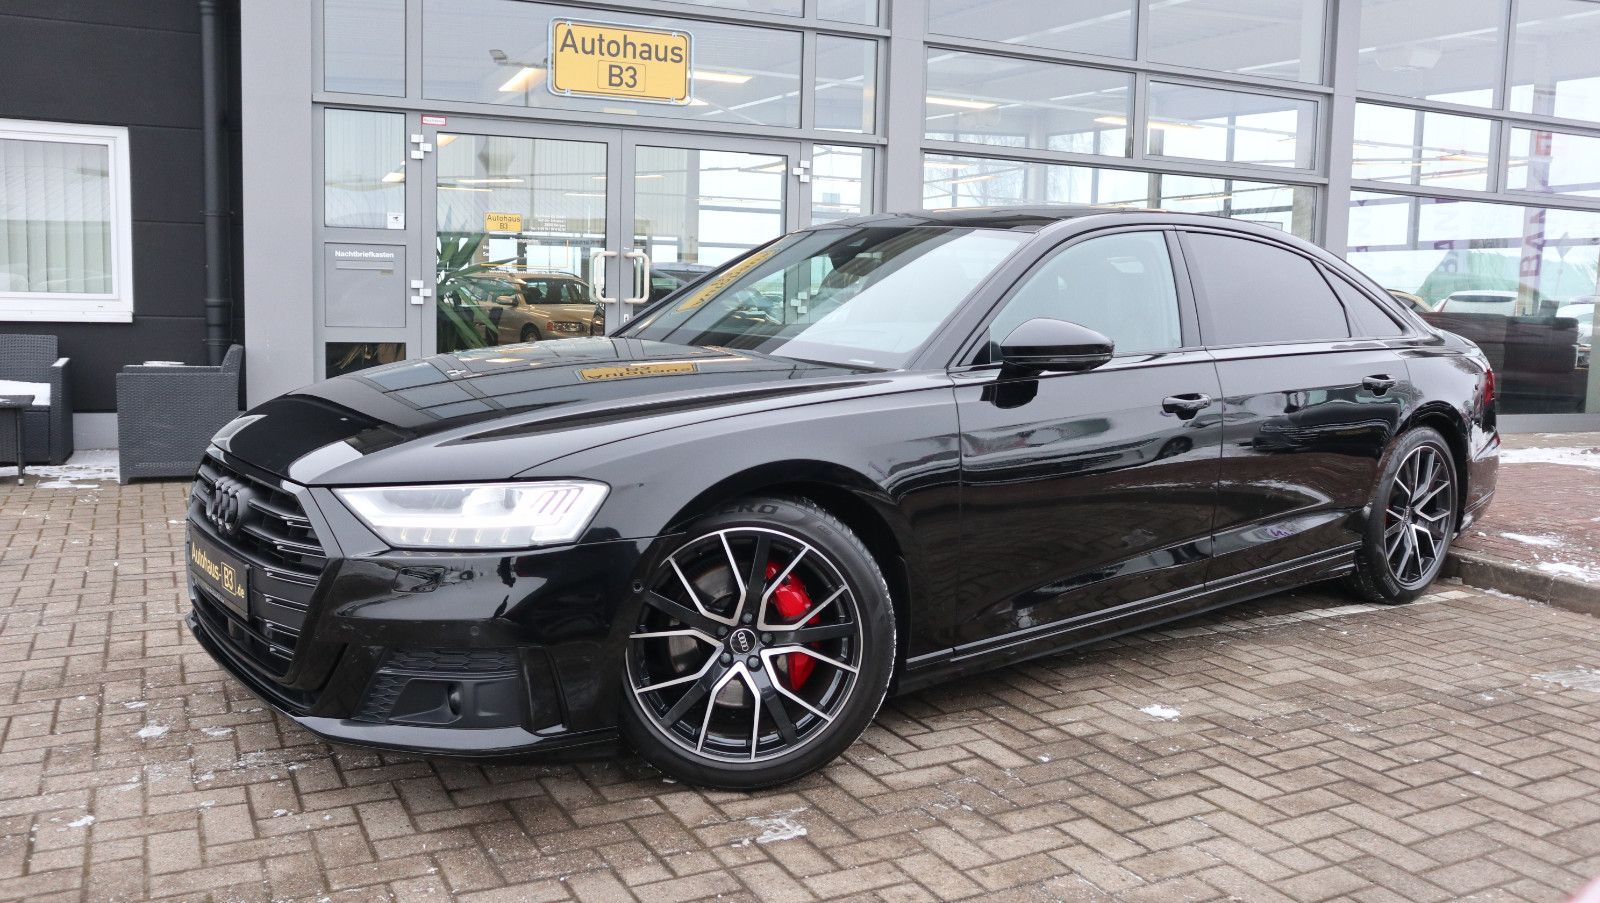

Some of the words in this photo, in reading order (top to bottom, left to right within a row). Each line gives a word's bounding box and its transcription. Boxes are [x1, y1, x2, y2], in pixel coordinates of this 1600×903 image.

[560, 28, 684, 64] Autohaus
[608, 64, 638, 88] B3
[486, 213, 521, 223] Autohaus
[334, 249, 395, 259] Nachtbriefkasten
[223, 566, 234, 591] B3
